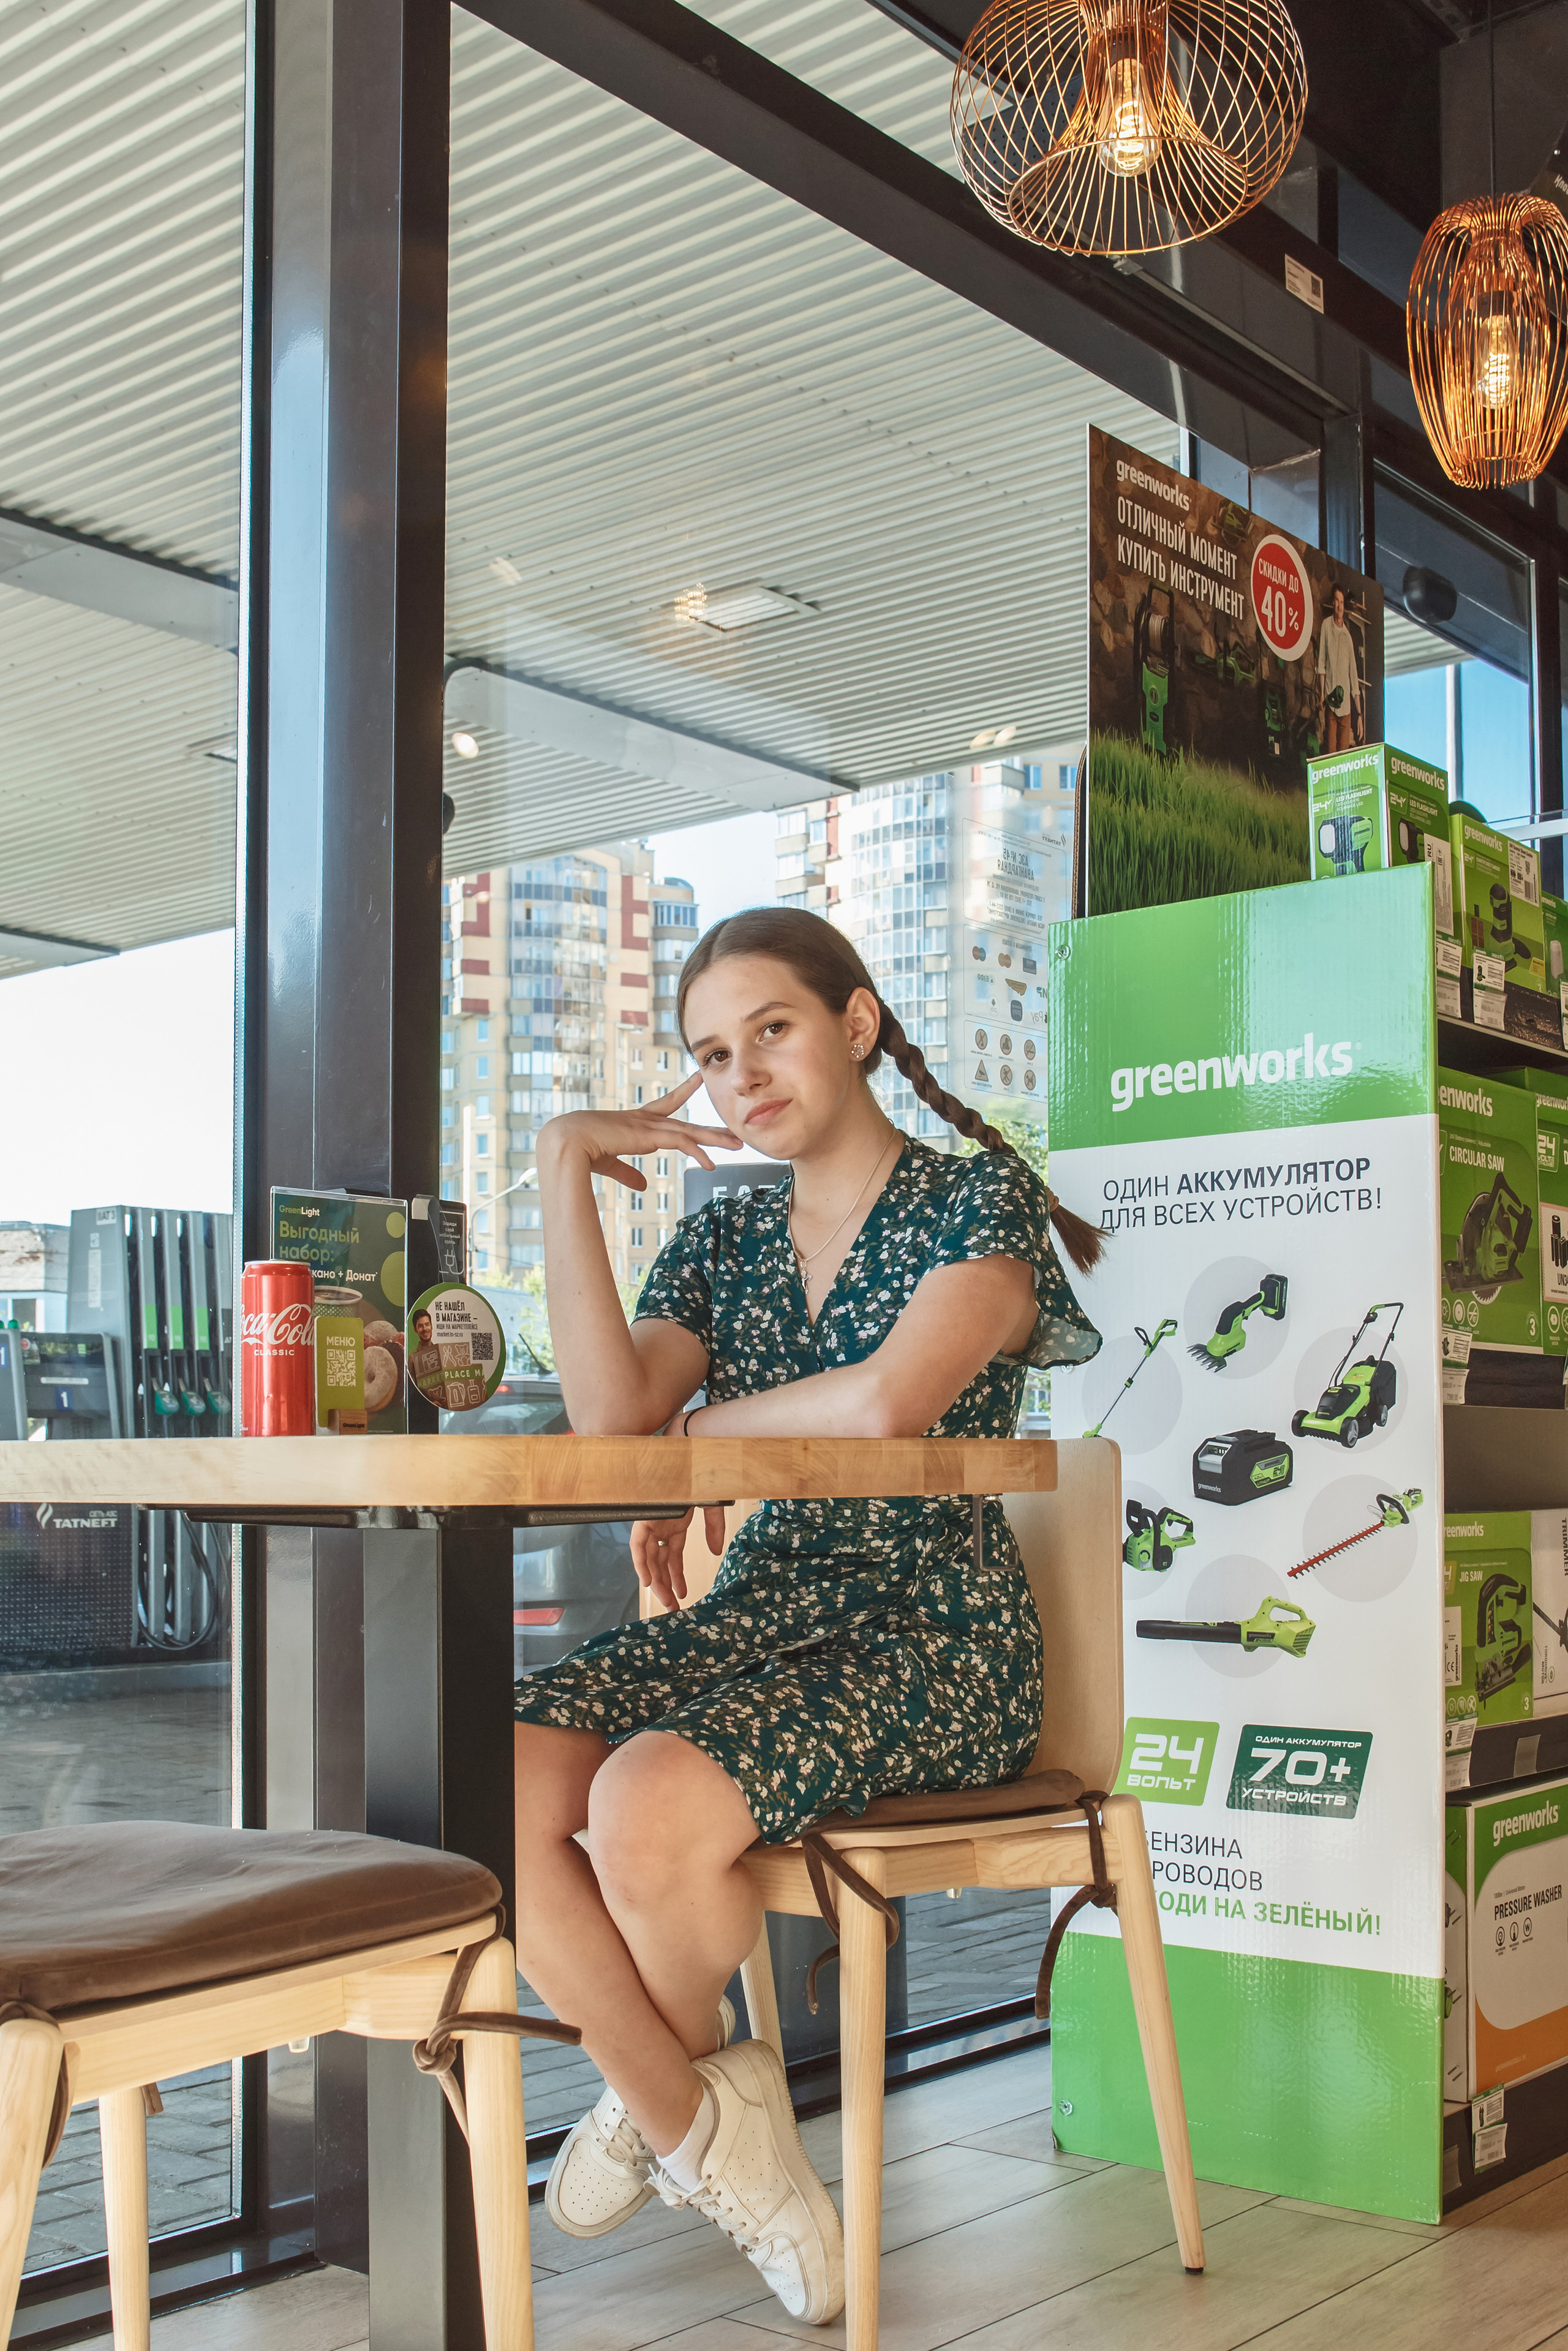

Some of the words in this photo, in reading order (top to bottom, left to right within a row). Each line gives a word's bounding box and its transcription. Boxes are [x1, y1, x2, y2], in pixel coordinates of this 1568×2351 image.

[1116, 459, 1190, 511] greenworks
[1118, 496, 1185, 554] ОТЛИЧНЫЙ
[1191, 532, 1237, 580] МОМЕНТ
[1118, 535, 1166, 582] КУПИТЬ
[1170, 562, 1244, 620] ИНСТРУМЕНТ
[1259, 558, 1286, 587] СКИДКИ
[1289, 576, 1299, 593] ДО
[1312, 753, 1379, 785] greenworks
[1391, 757, 1445, 791] greenworks
[1345, 788, 1373, 800] FLASHLIGHT
[1416, 801, 1438, 817] FLASHLIGHT
[1464, 824, 1502, 852] greenworks
[1427, 843, 1432, 858] RU
[1110, 1033, 1353, 1112] greenworks
[1439, 1085, 1493, 1117] enworks
[1536, 1093, 1568, 1111] greenwor
[1538, 1134, 1555, 1155] 24
[1450, 1145, 1486, 1168] CIRCULAR
[1488, 1154, 1504, 1172] SAW
[1103, 1175, 1169, 1204] ОДИН
[1177, 1157, 1371, 1194] АККУМУЛЯТОР
[279, 1205, 320, 1217] GreenLight
[1101, 1207, 1145, 1233] ДЛЯ
[1155, 1201, 1215, 1226] ВСЕХ
[1223, 1187, 1381, 1221] УСТРОЙСТВ!
[279, 1221, 360, 1243] Выгодный
[279, 1245, 334, 1264] набор:
[312, 1270, 335, 1280] кано
[435, 1302, 442, 1311] НЕ
[444, 1300, 465, 1311] НАШЁЛ
[436, 1313, 440, 1322] В
[442, 1313, 471, 1322] МАГАЗИНЕ
[1529, 1318, 1536, 1337] 3
[326, 1335, 355, 1347] МЕНЮ
[445, 1370, 470, 1379] PLACE
[61, 1392, 68, 1408] 1
[1198, 1482, 1221, 1493] greenworks
[53, 1519, 118, 1528] TATNEFT
[1444, 1522, 1484, 1538] reenworks
[1460, 1572, 1469, 1583] JIG
[1470, 1571, 1483, 1582] SAW
[1524, 1697, 1529, 1710] 3
[1255, 1735, 1284, 1744] ОДИН
[1286, 1737, 1362, 1748] АККУМУЛЯТОР
[1129, 1733, 1204, 1774] 24
[1250, 1748, 1351, 1785] 70+
[1126, 1774, 1196, 1791] ВОЛЬТ
[1242, 1787, 1346, 1806] УСТРОЙСТВ
[1493, 1800, 1559, 1846] greenworks
[1153, 1861, 1263, 1892] РОВОДОВ
[1494, 1895, 1532, 1920] PRESSURE
[1533, 1884, 1562, 1908] WASHER
[1215, 1897, 1246, 1920] НА
[1254, 1901, 1381, 1936] ЗЕЛЁНЫЙ!
